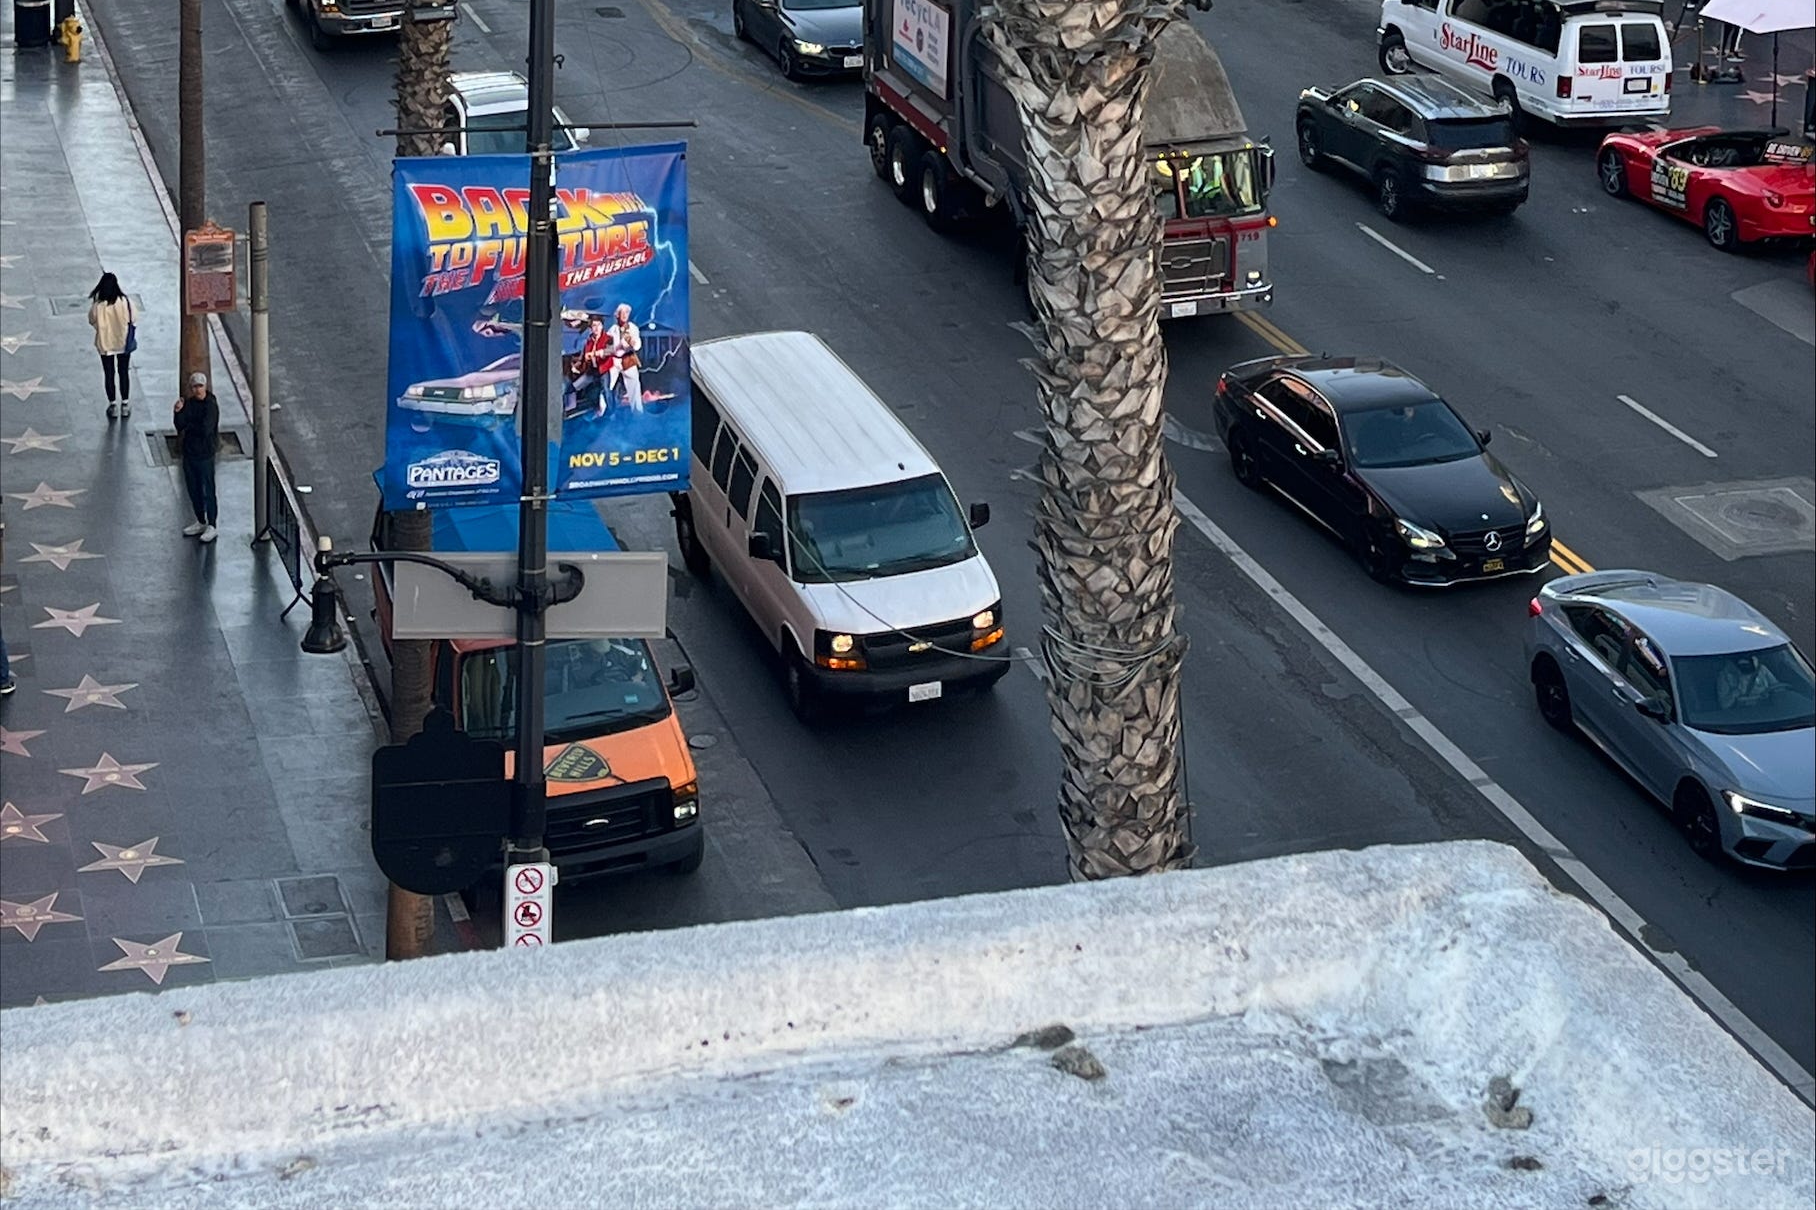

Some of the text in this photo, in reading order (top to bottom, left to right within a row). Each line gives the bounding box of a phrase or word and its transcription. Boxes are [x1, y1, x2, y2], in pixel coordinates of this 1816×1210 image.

[1505, 56, 1547, 86] TOURS
[429, 242, 474, 272] TO
[565, 251, 648, 287] THE MUSICAL
[420, 269, 470, 297] THE
[411, 462, 496, 482] PANTAGES
[569, 452, 606, 468] NOV
[609, 451, 620, 466] 5
[635, 448, 668, 464] DEC
[672, 447, 679, 461] 1
